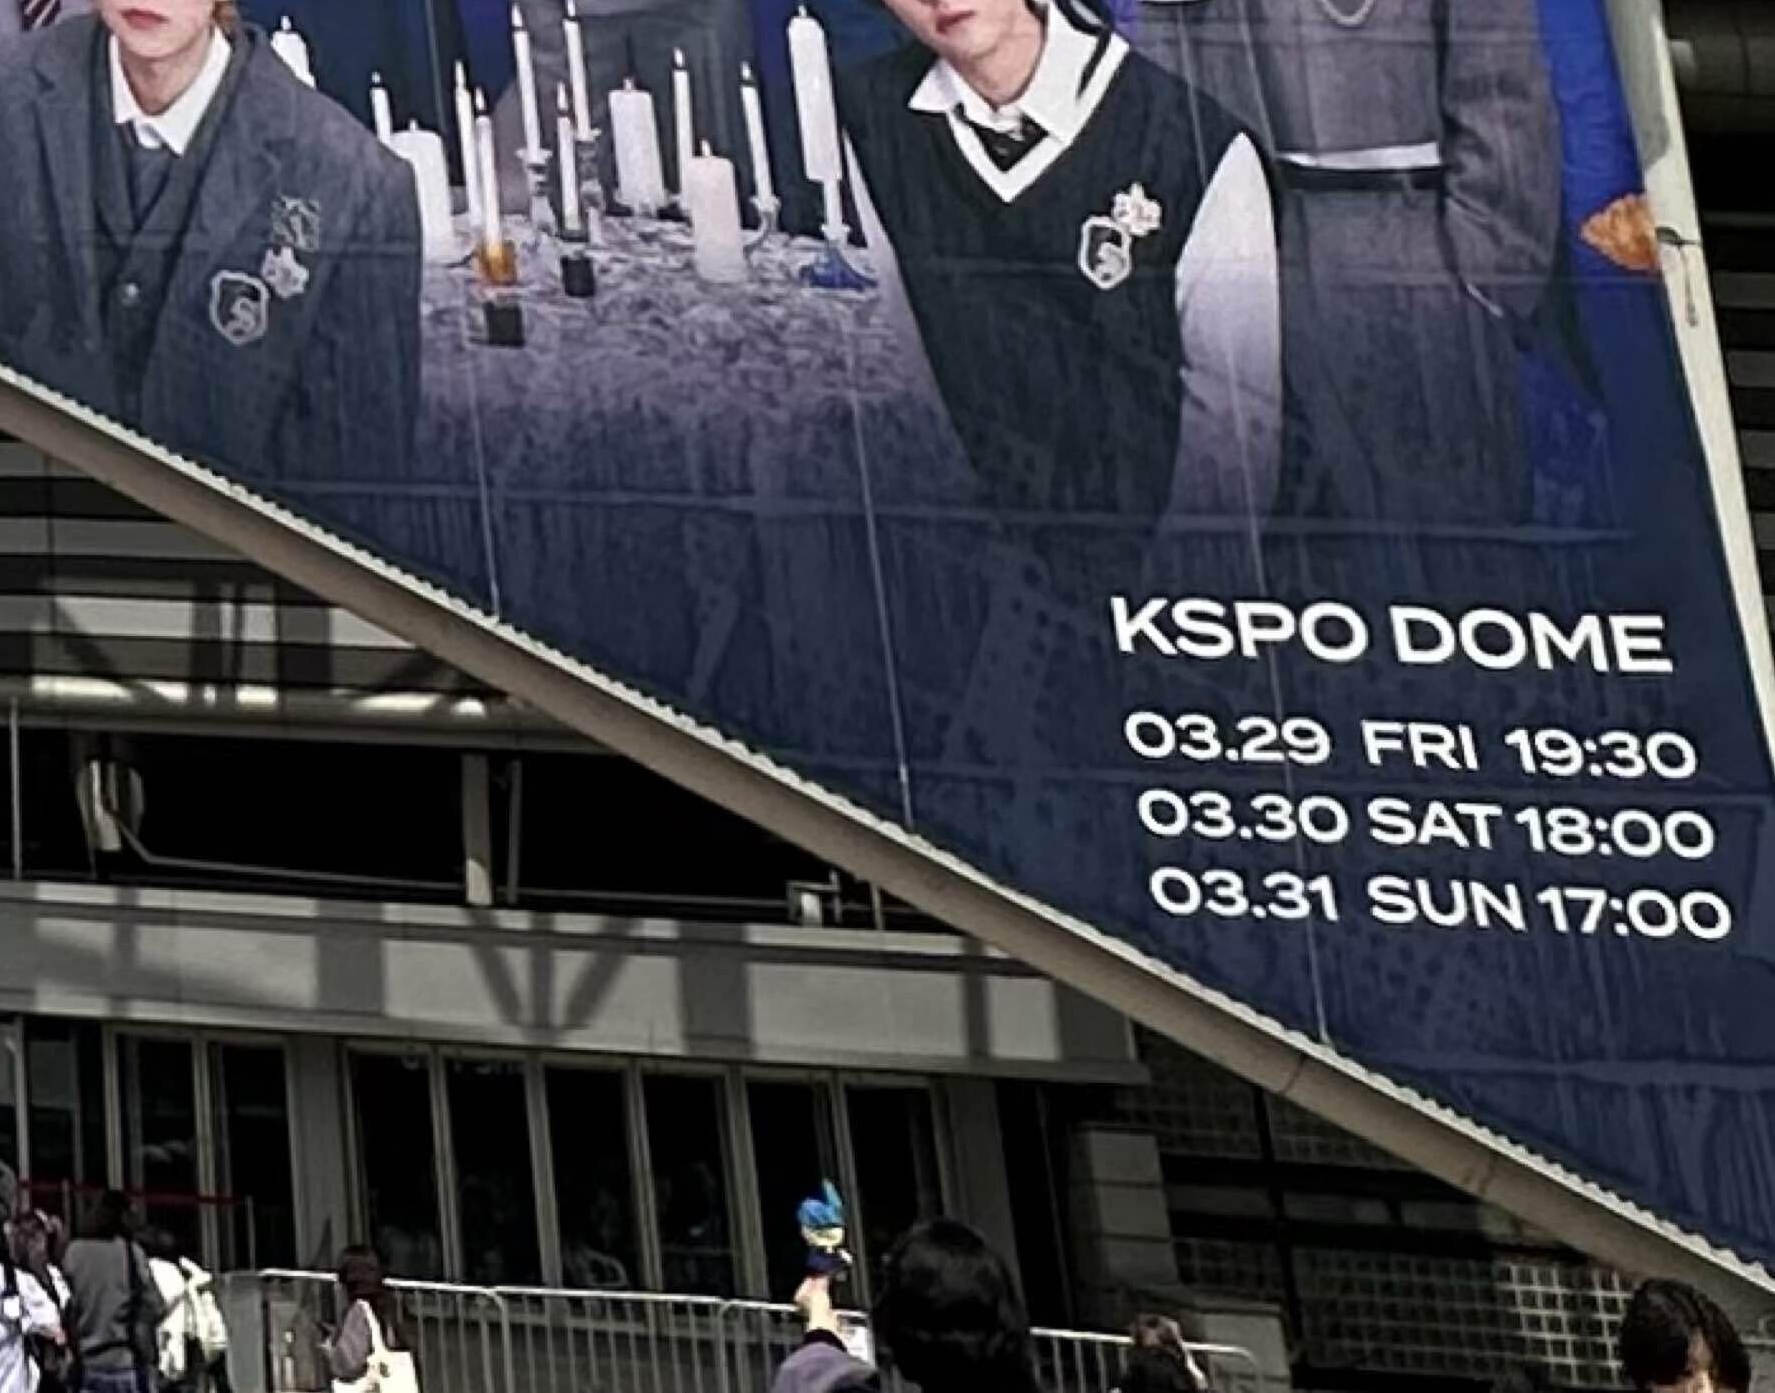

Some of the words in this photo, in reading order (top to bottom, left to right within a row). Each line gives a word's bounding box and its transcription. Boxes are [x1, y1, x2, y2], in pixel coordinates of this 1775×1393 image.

[1110, 597, 1368, 662] KSPO
[1390, 606, 1673, 672] DOME
[1125, 711, 1330, 764] 03.29
[1361, 719, 1478, 770] FRI
[1504, 729, 1696, 779] 19:30
[1138, 789, 1349, 843] 03.30
[1367, 798, 1503, 849] SAT
[1515, 807, 1714, 858] 18:00
[1151, 867, 1338, 921] 03.31
[1367, 876, 1526, 930] SUN
[1537, 887, 1732, 939] 17:00
